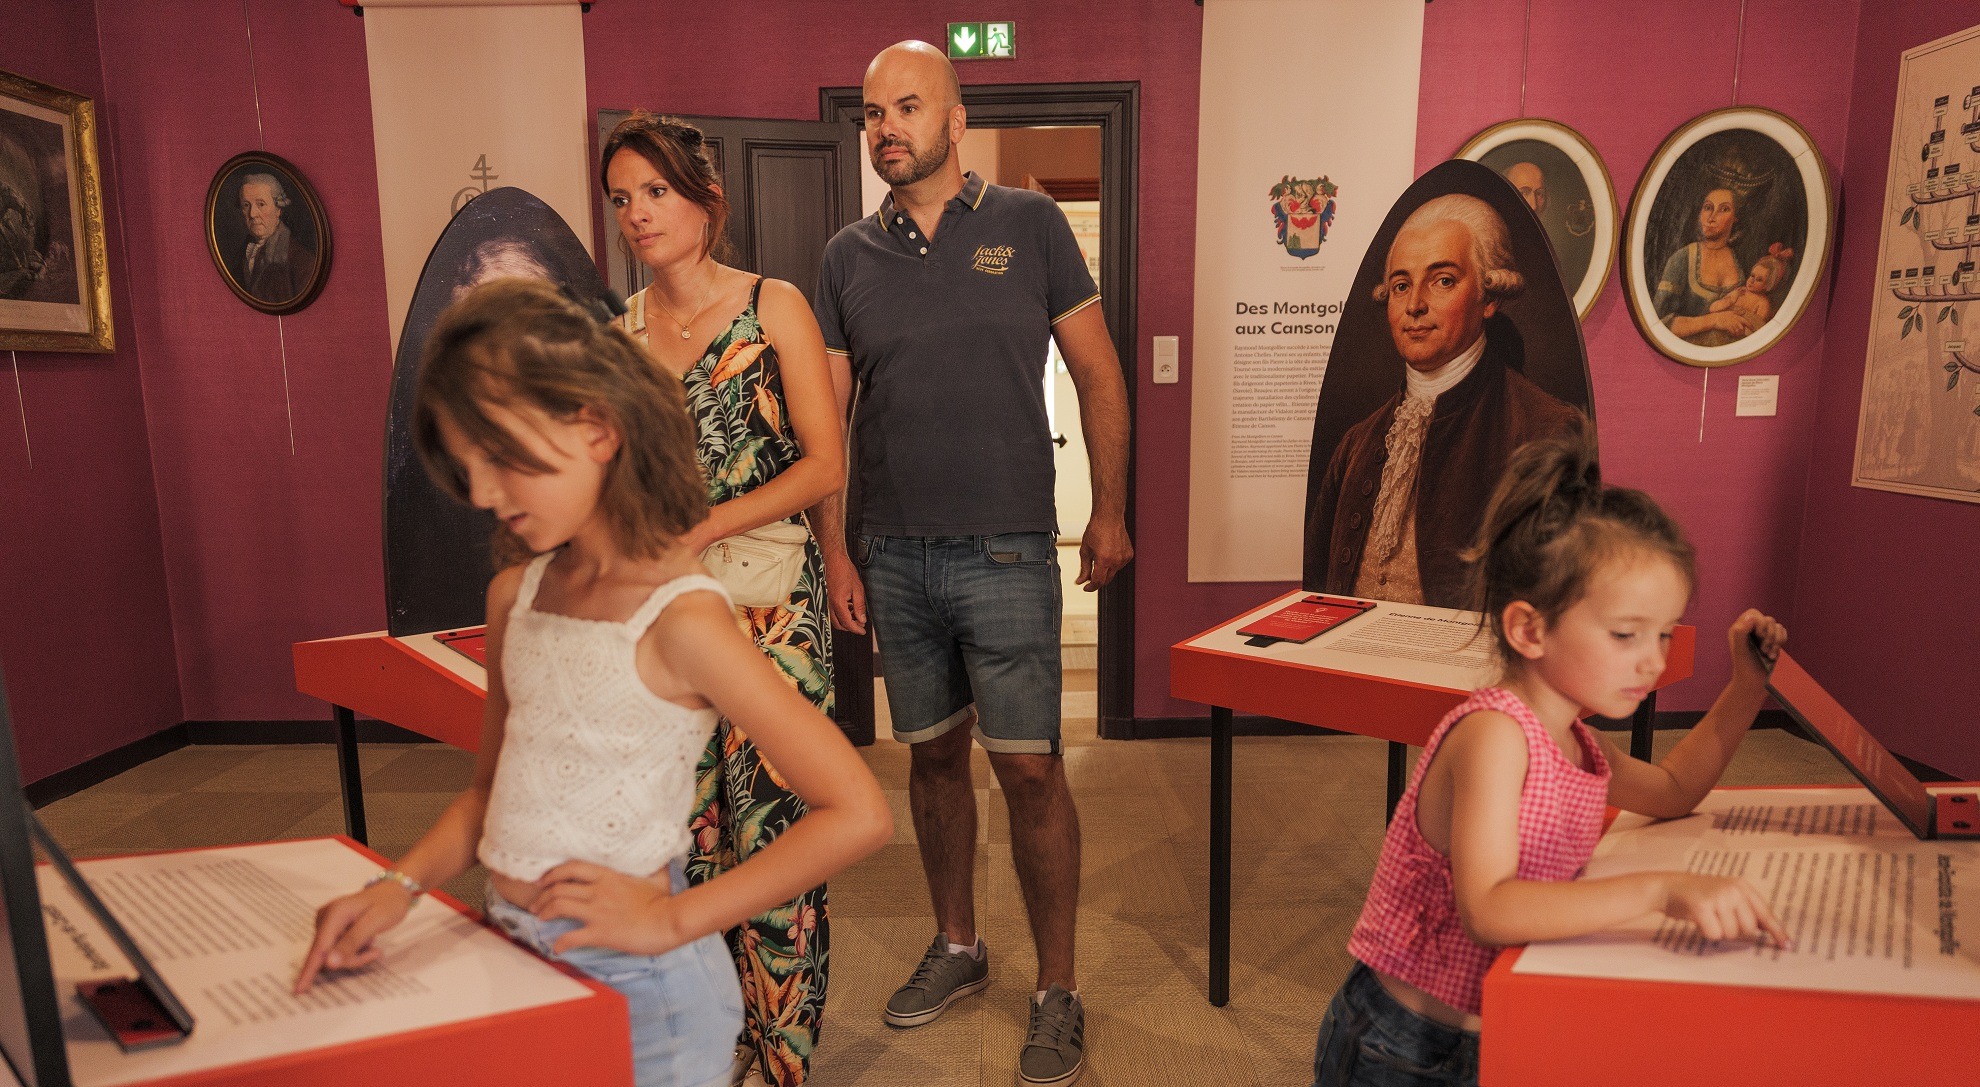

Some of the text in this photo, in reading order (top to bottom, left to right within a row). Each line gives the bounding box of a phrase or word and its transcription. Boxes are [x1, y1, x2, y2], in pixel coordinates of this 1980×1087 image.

[1236, 301, 1269, 315] Des
[1235, 321, 1335, 335] aux Canson
